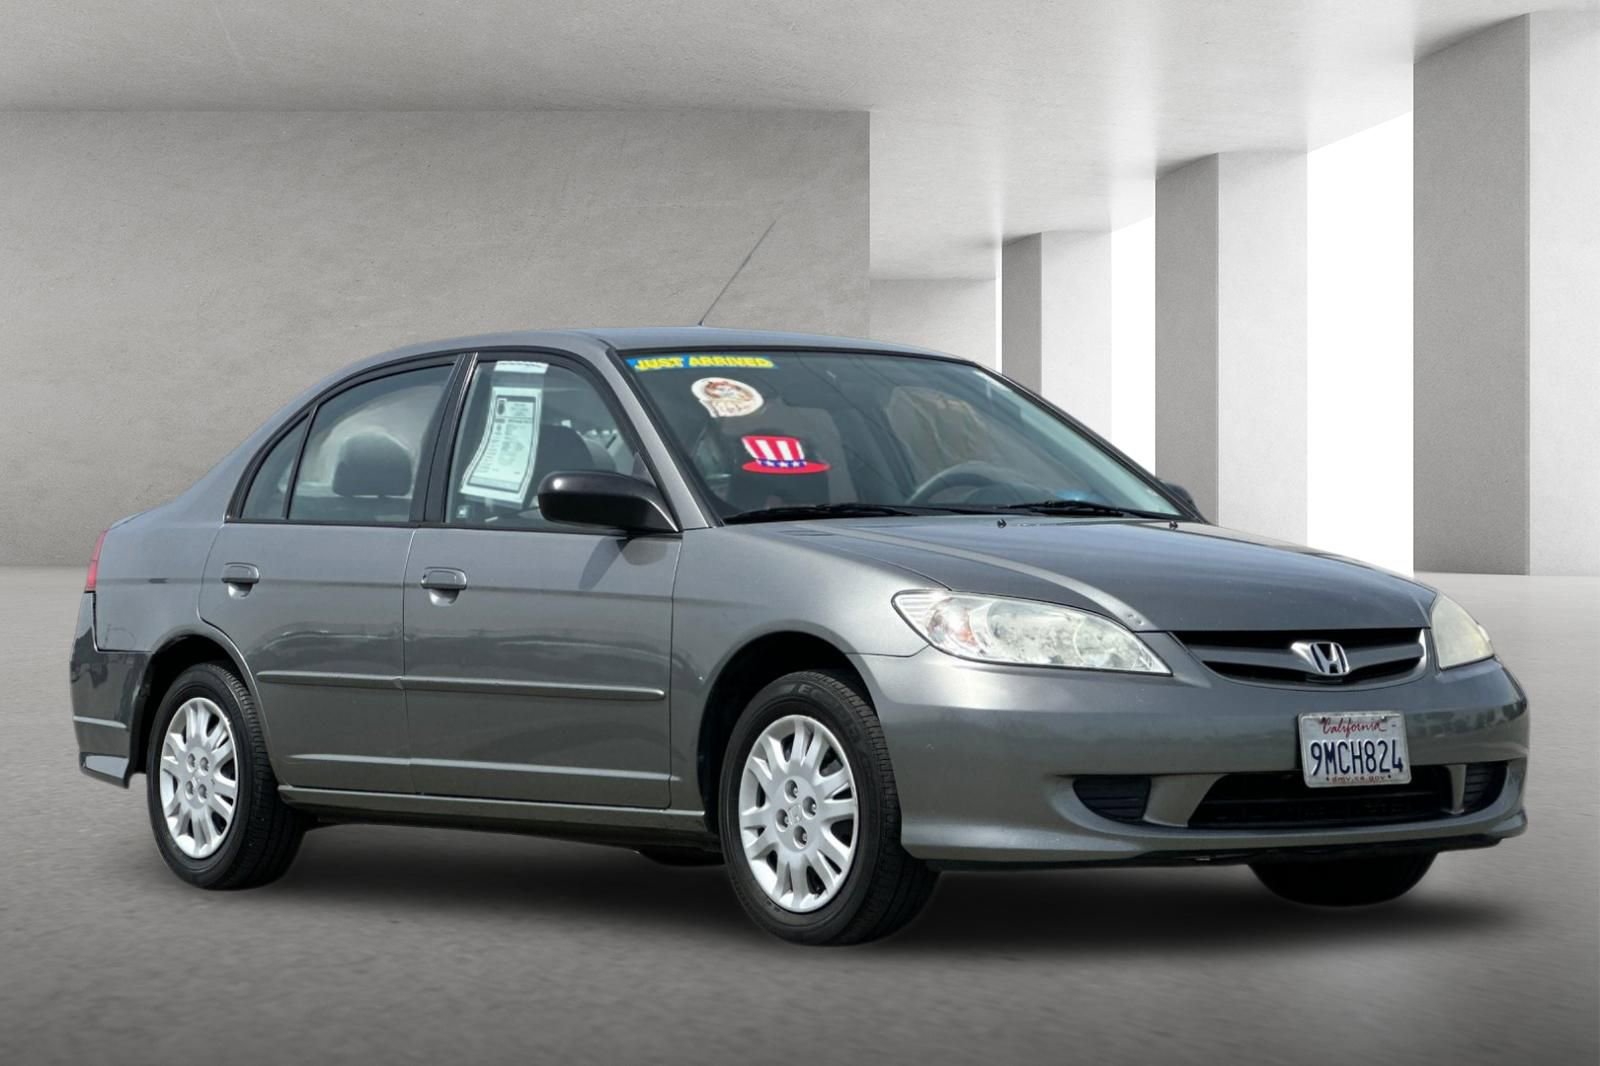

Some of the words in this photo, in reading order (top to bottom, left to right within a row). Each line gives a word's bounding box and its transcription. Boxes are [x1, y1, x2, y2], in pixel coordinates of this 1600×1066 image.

[634, 357, 684, 371] JUST
[688, 355, 774, 369] ARRIVED
[1321, 717, 1387, 738] California
[1310, 739, 1404, 777] 9MCH824
